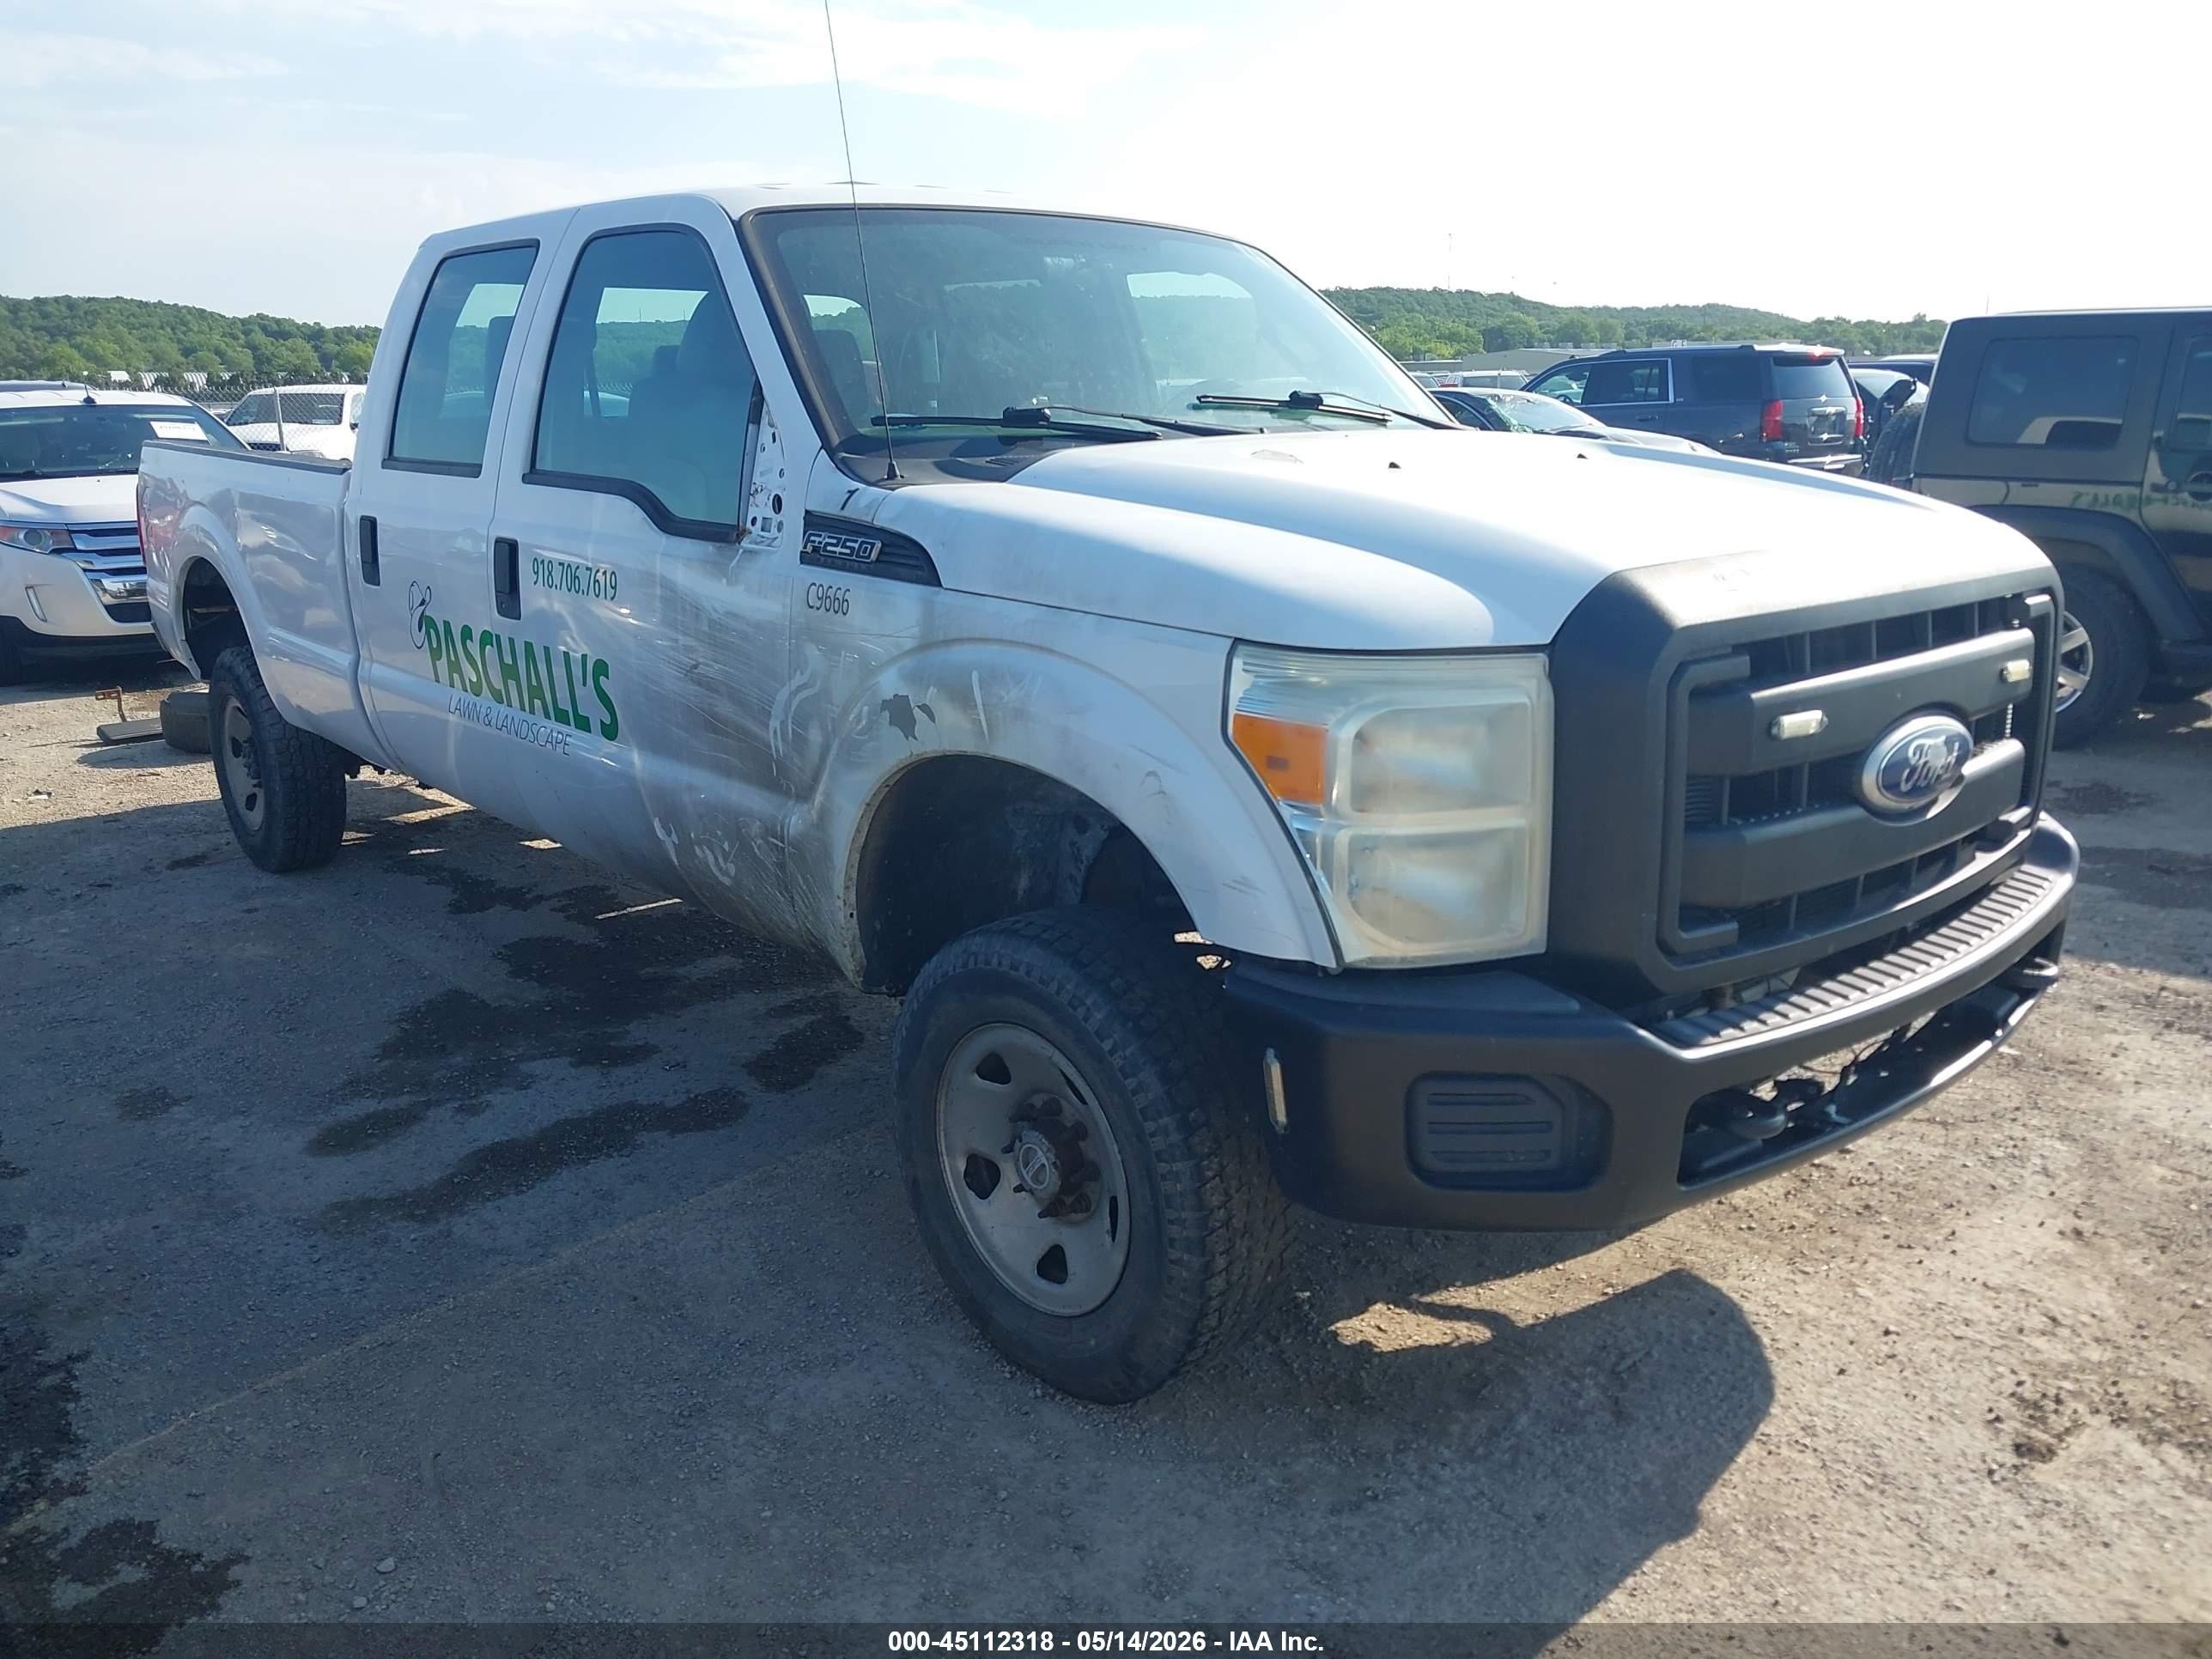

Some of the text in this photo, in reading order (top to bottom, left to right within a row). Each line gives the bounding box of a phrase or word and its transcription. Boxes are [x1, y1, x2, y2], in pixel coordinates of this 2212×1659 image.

[802, 530, 882, 562] F-250
[532, 556, 617, 601] 918.706.7619
[806, 581, 851, 616] C9666
[424, 614, 619, 741] PASCHALL'S
[448, 694, 573, 757] LAWN & LANDSCAPE
[1900, 734, 1960, 793] Ford
